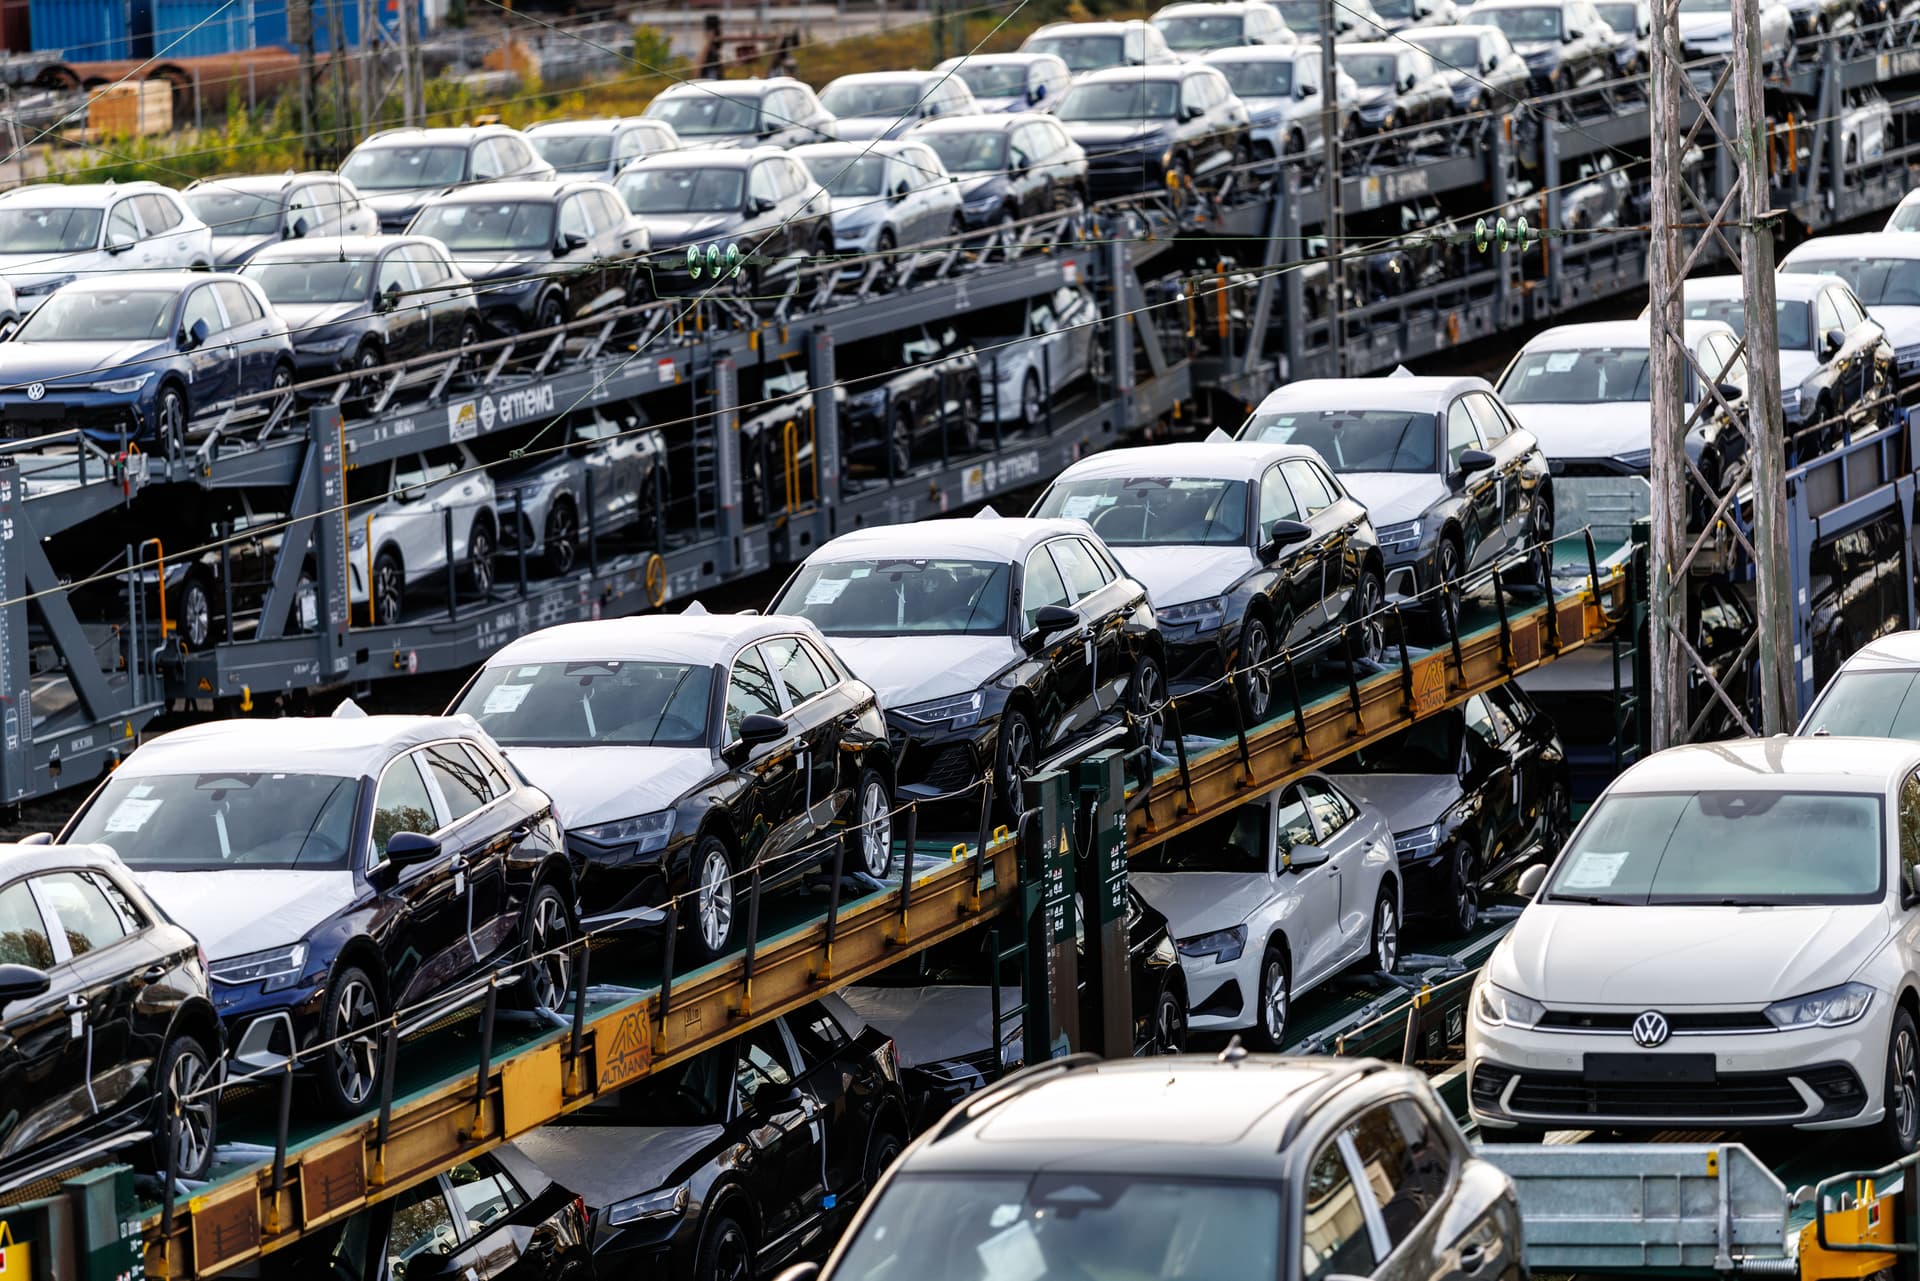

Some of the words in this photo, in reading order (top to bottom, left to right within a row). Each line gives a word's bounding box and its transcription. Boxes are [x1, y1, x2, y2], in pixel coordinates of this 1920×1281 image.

[499, 383, 555, 422] ermewa
[608, 1006, 648, 1058] ARS
[1633, 1011, 1668, 1047] VW
[598, 1052, 649, 1090] ALTMANN
